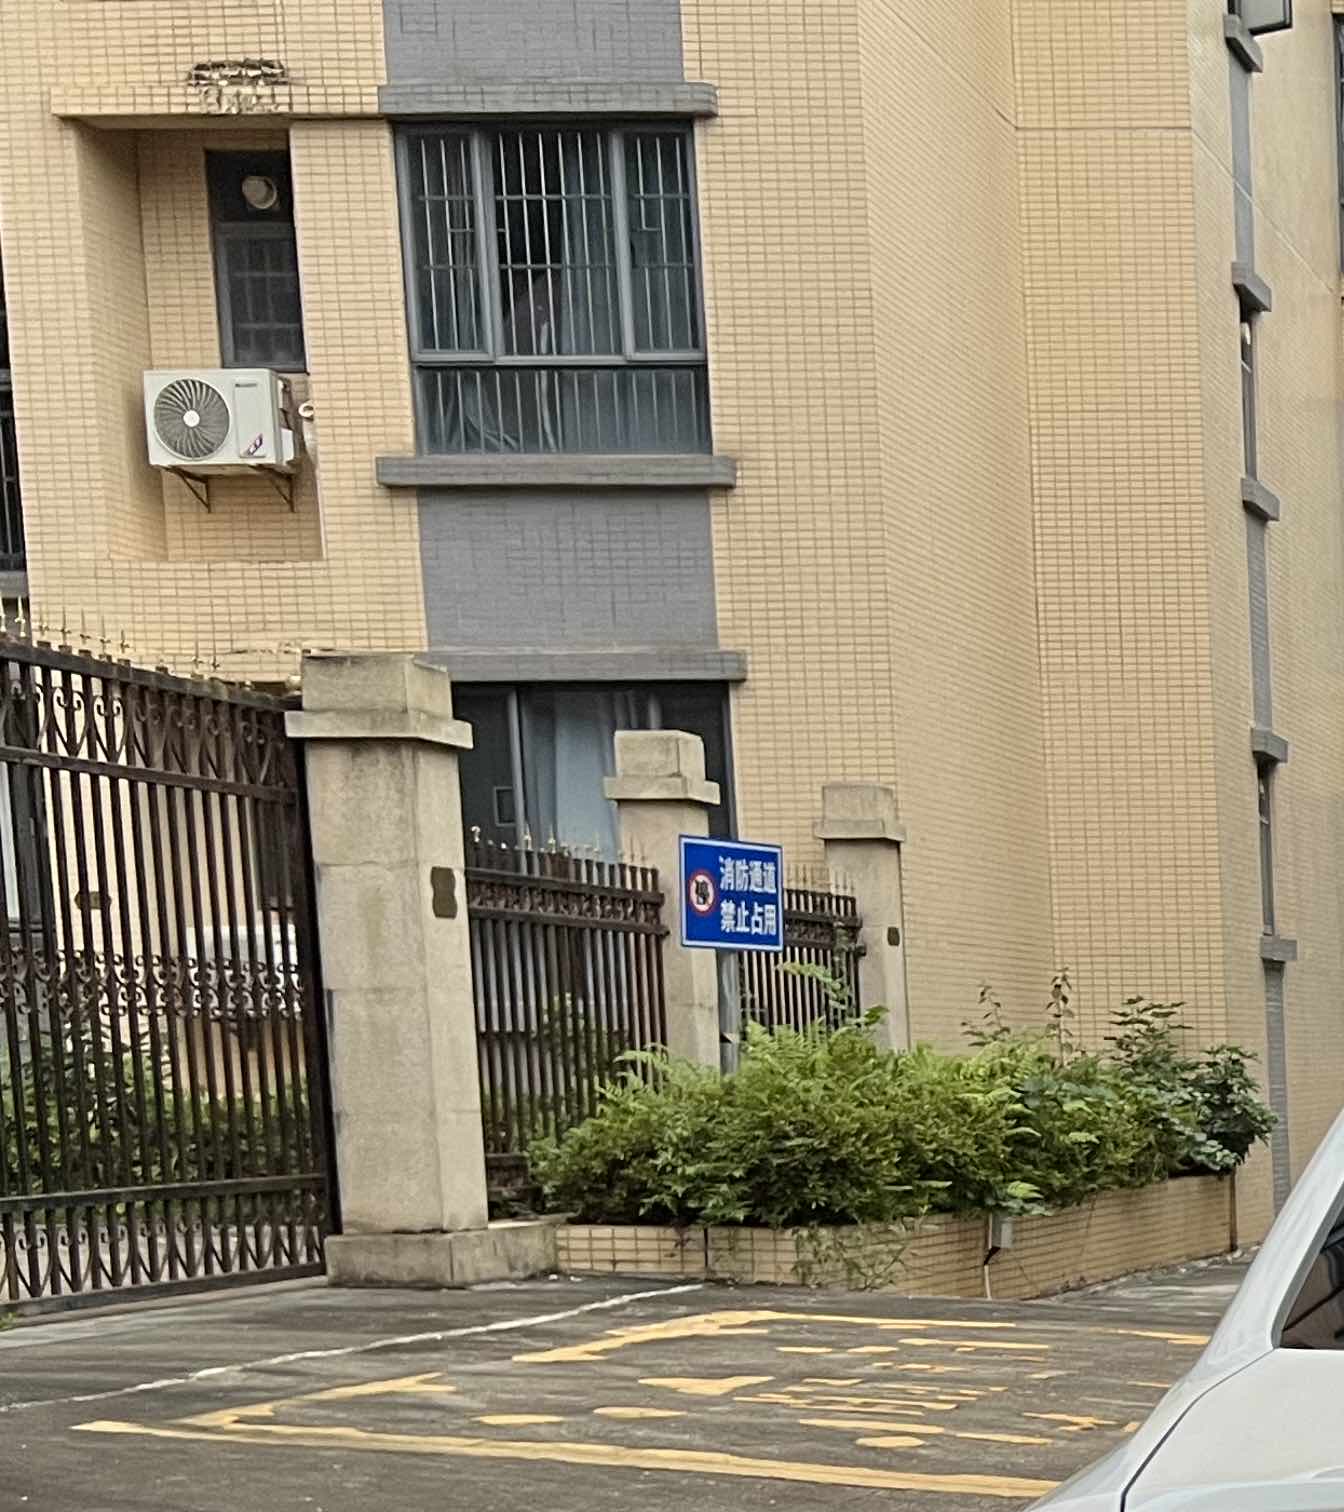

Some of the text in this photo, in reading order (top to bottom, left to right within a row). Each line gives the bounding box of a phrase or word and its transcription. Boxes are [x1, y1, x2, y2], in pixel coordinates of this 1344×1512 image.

[718, 855, 777, 894] 消防通道
[719, 899, 777, 936] 禁止占用
